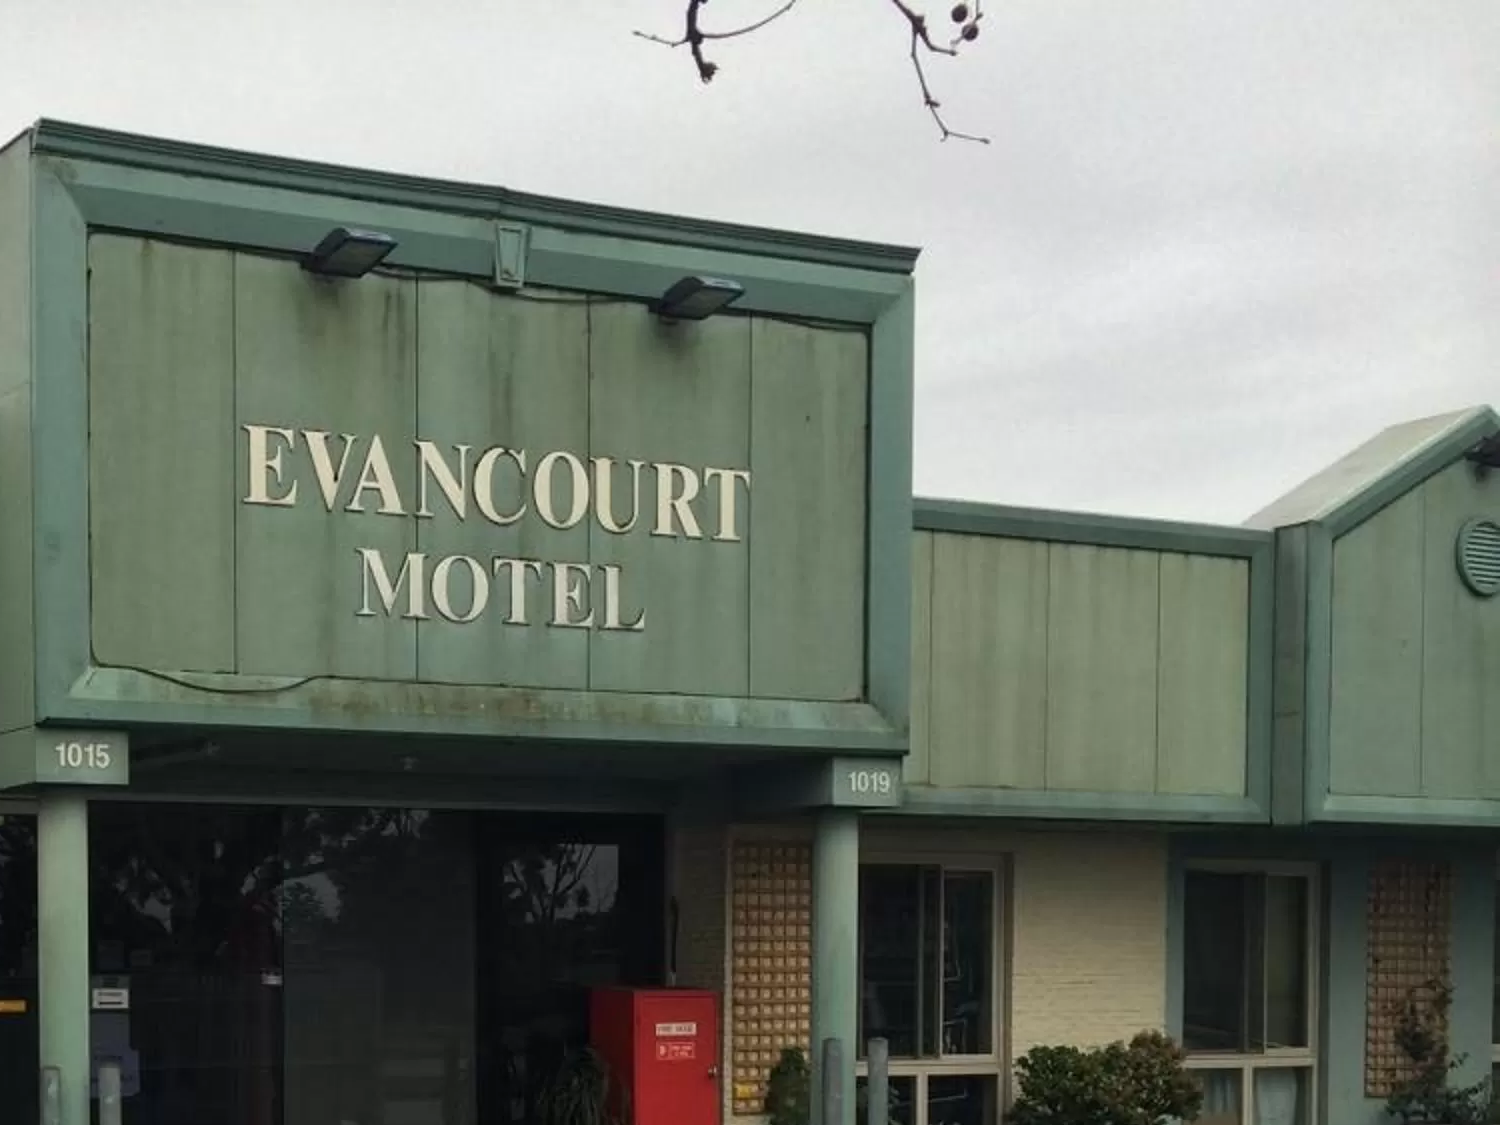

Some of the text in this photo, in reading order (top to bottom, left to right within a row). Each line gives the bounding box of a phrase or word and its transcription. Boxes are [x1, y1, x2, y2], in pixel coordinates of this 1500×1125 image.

[242, 423, 750, 541] EVANCOURT
[356, 547, 645, 631] MOTEL
[55, 742, 111, 769] 1015
[848, 771, 891, 793] 1019
